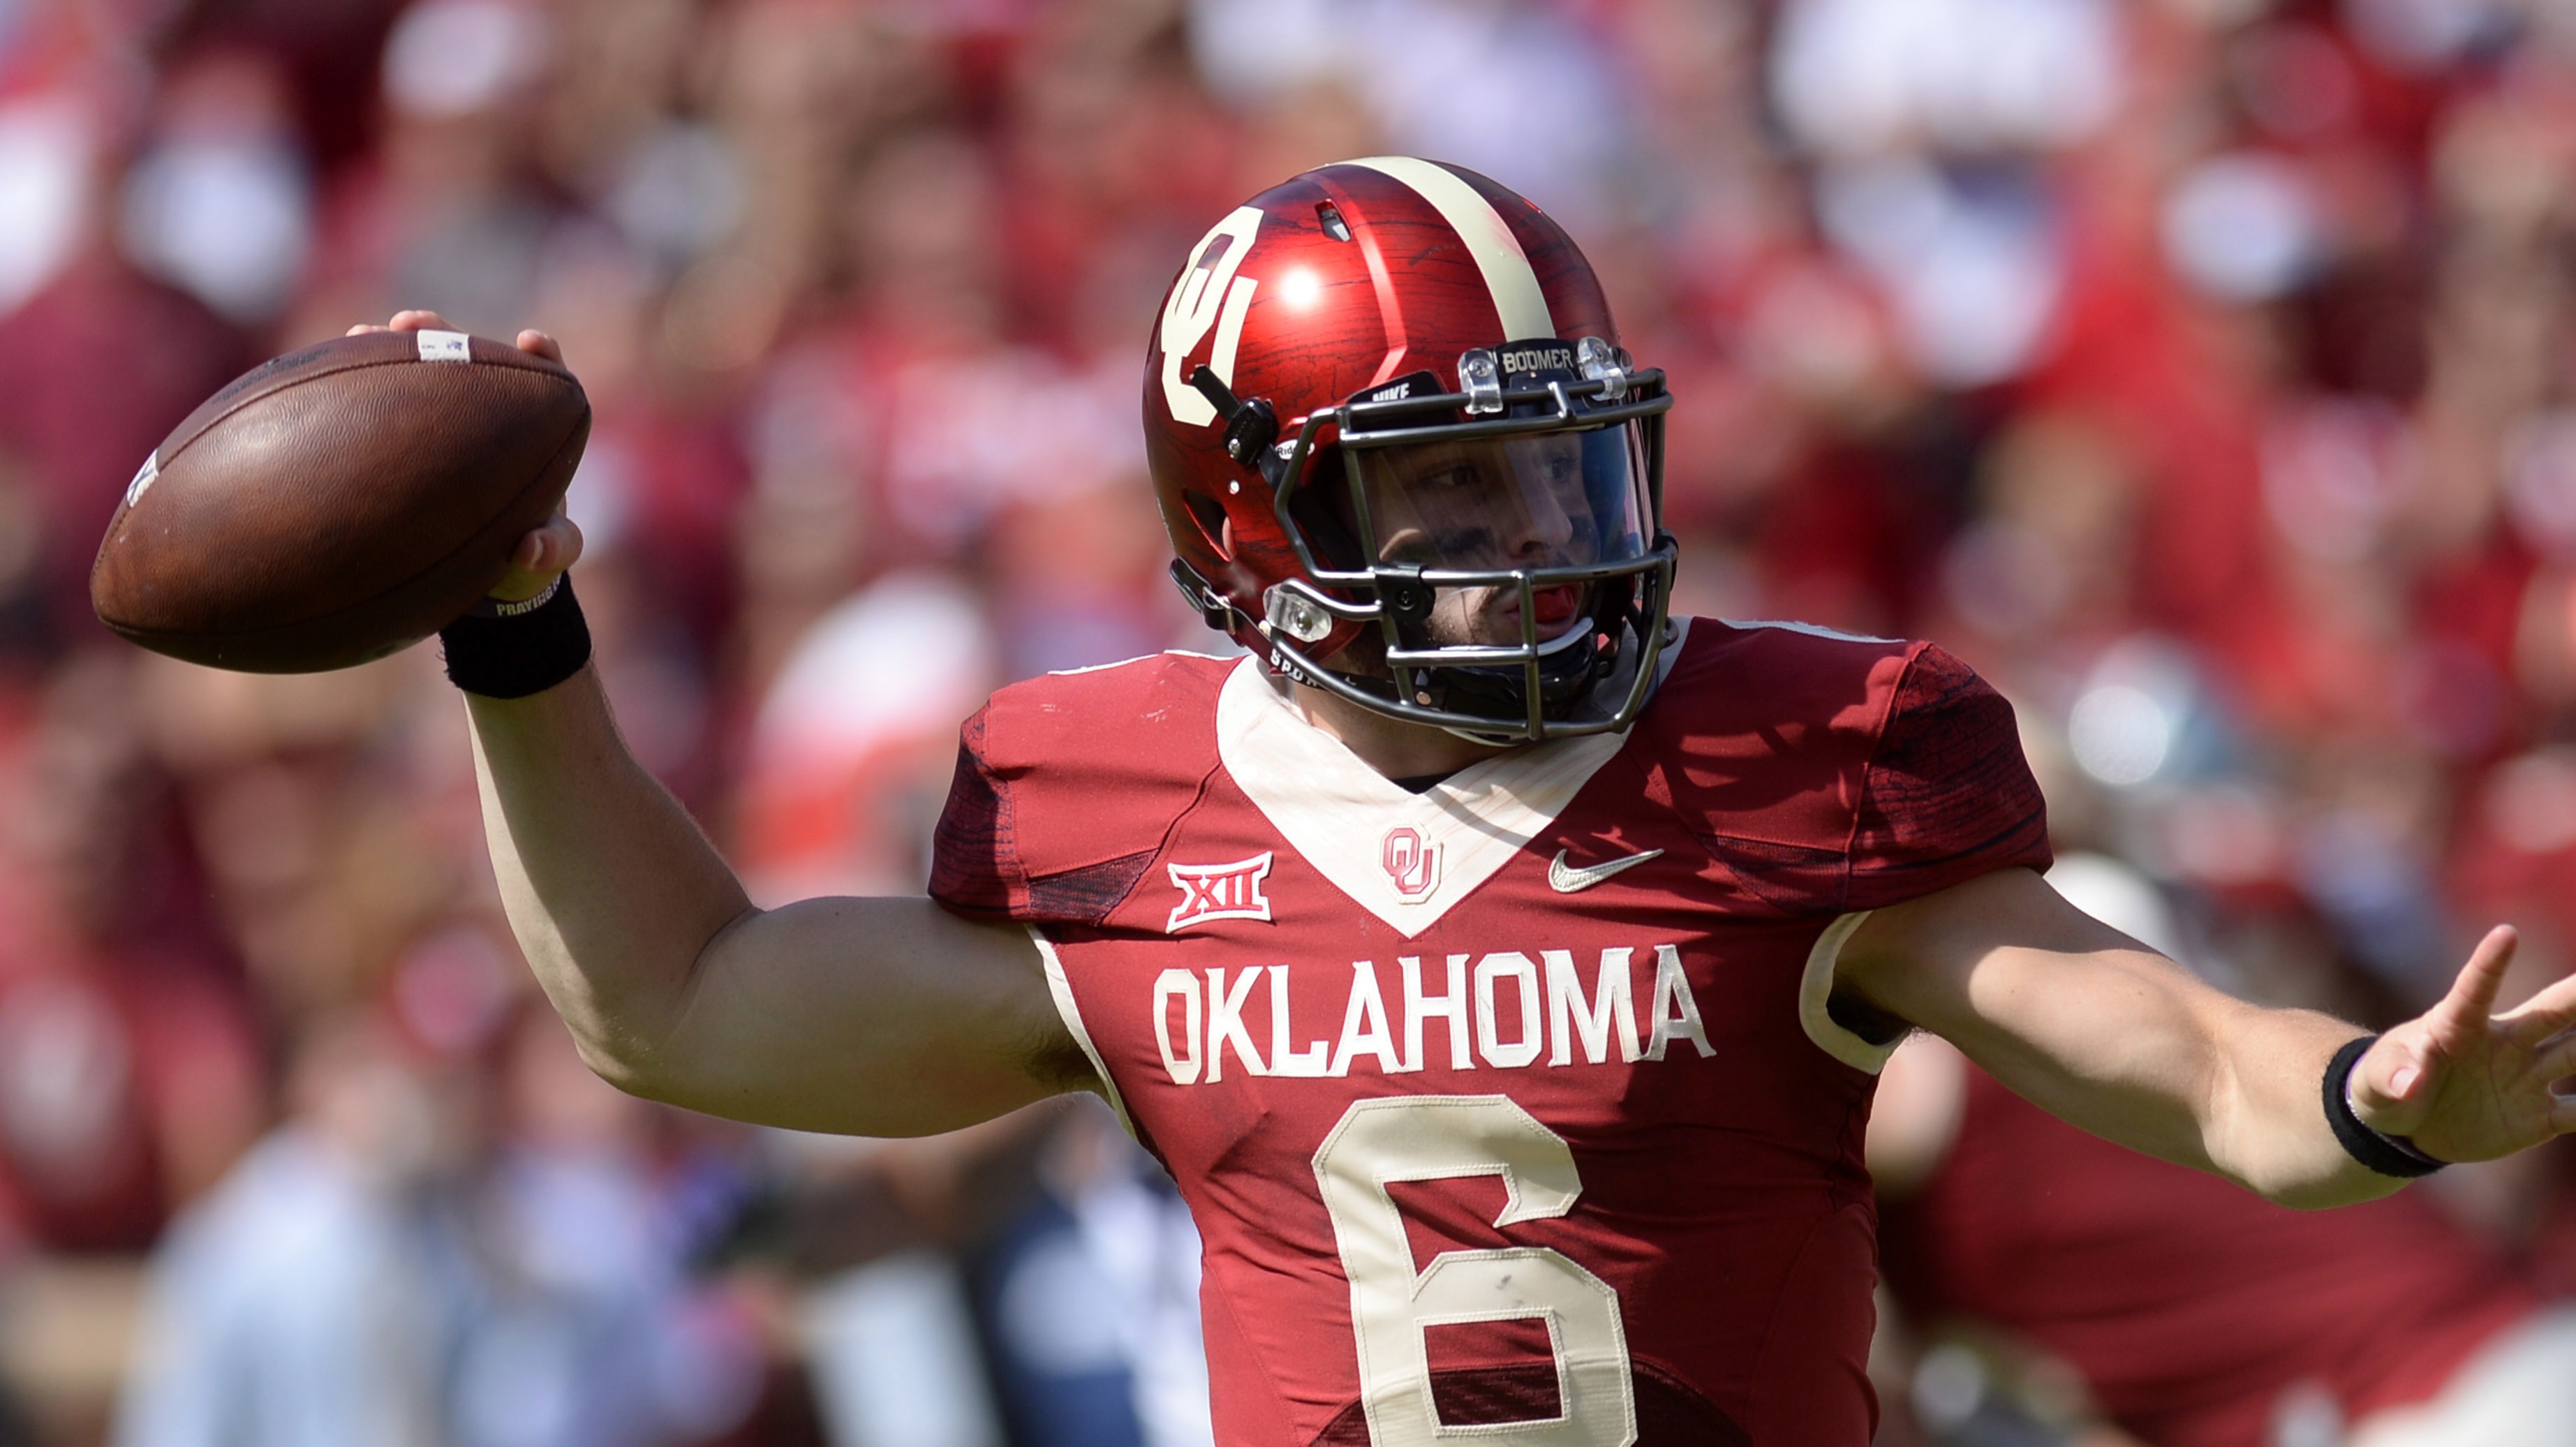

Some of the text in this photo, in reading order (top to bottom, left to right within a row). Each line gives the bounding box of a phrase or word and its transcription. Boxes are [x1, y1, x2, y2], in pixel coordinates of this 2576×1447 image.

[1161, 205, 1264, 427] OU
[1372, 382, 1409, 402] NIKE
[1502, 349, 1574, 374] BOOMER
[496, 586, 554, 616] PRAYING
[1174, 860, 1265, 923] XII
[1382, 826, 1434, 896] OU
[1153, 944, 1717, 1084] OKLAHOMA
[1311, 1094, 1639, 1447] 6
